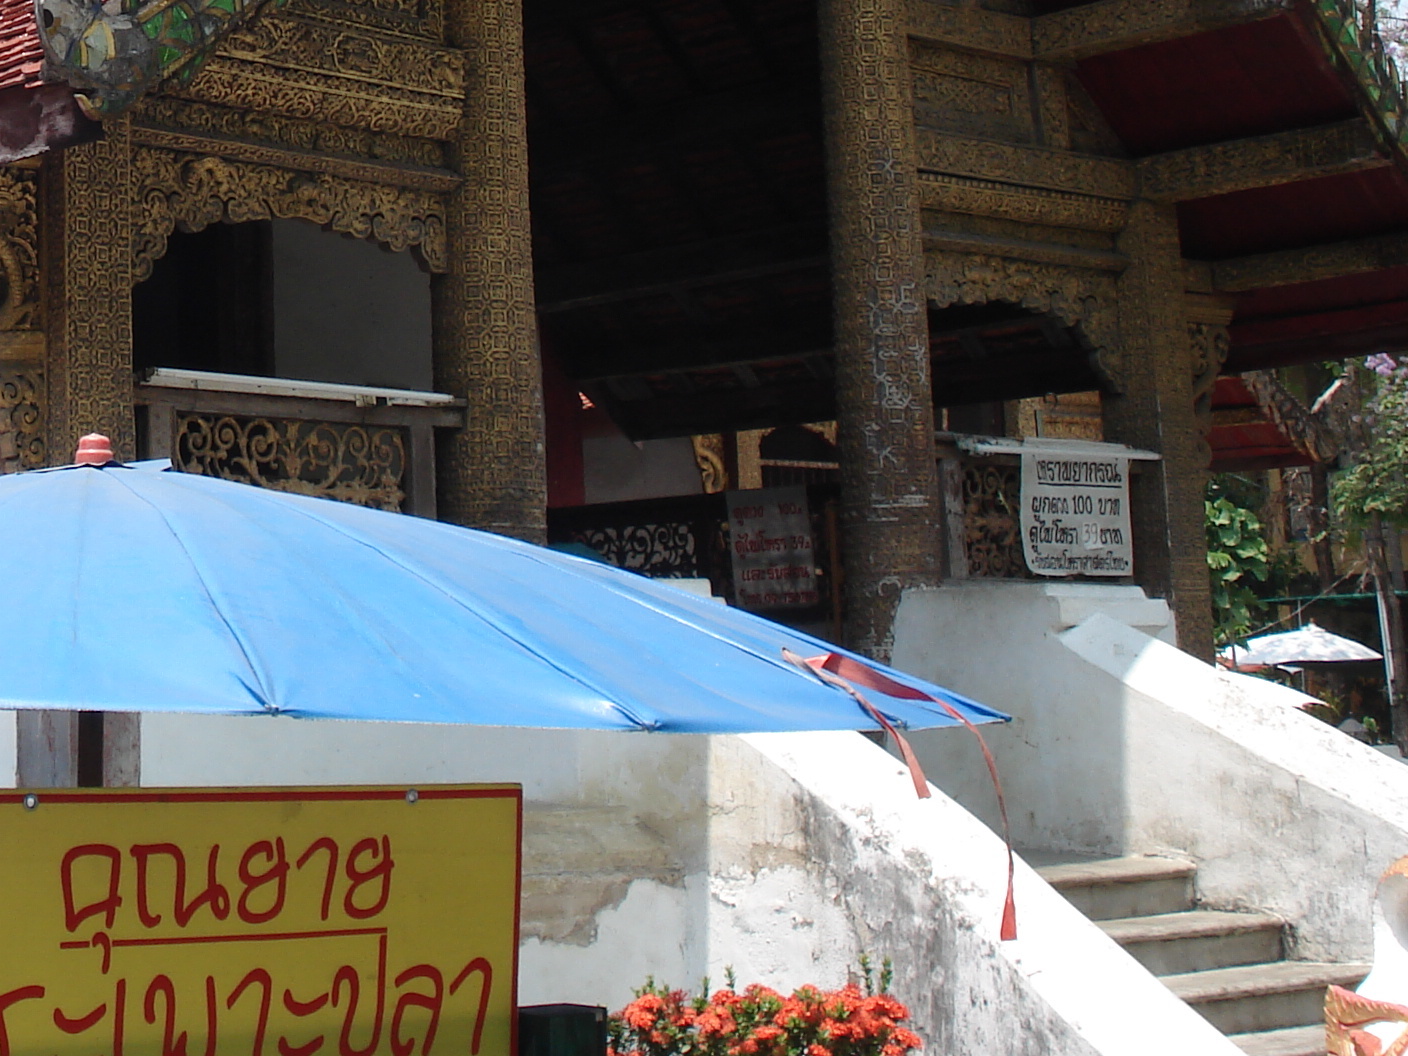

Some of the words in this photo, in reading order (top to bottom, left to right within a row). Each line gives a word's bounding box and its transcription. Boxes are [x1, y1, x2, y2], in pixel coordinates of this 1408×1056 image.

[1072, 495, 1093, 514] 100
[1098, 498, 1121, 516] บาท
[1084, 523, 1098, 544] 39
[1100, 527, 1123, 545] บาท
[59, 833, 395, 975] คุณยาย
